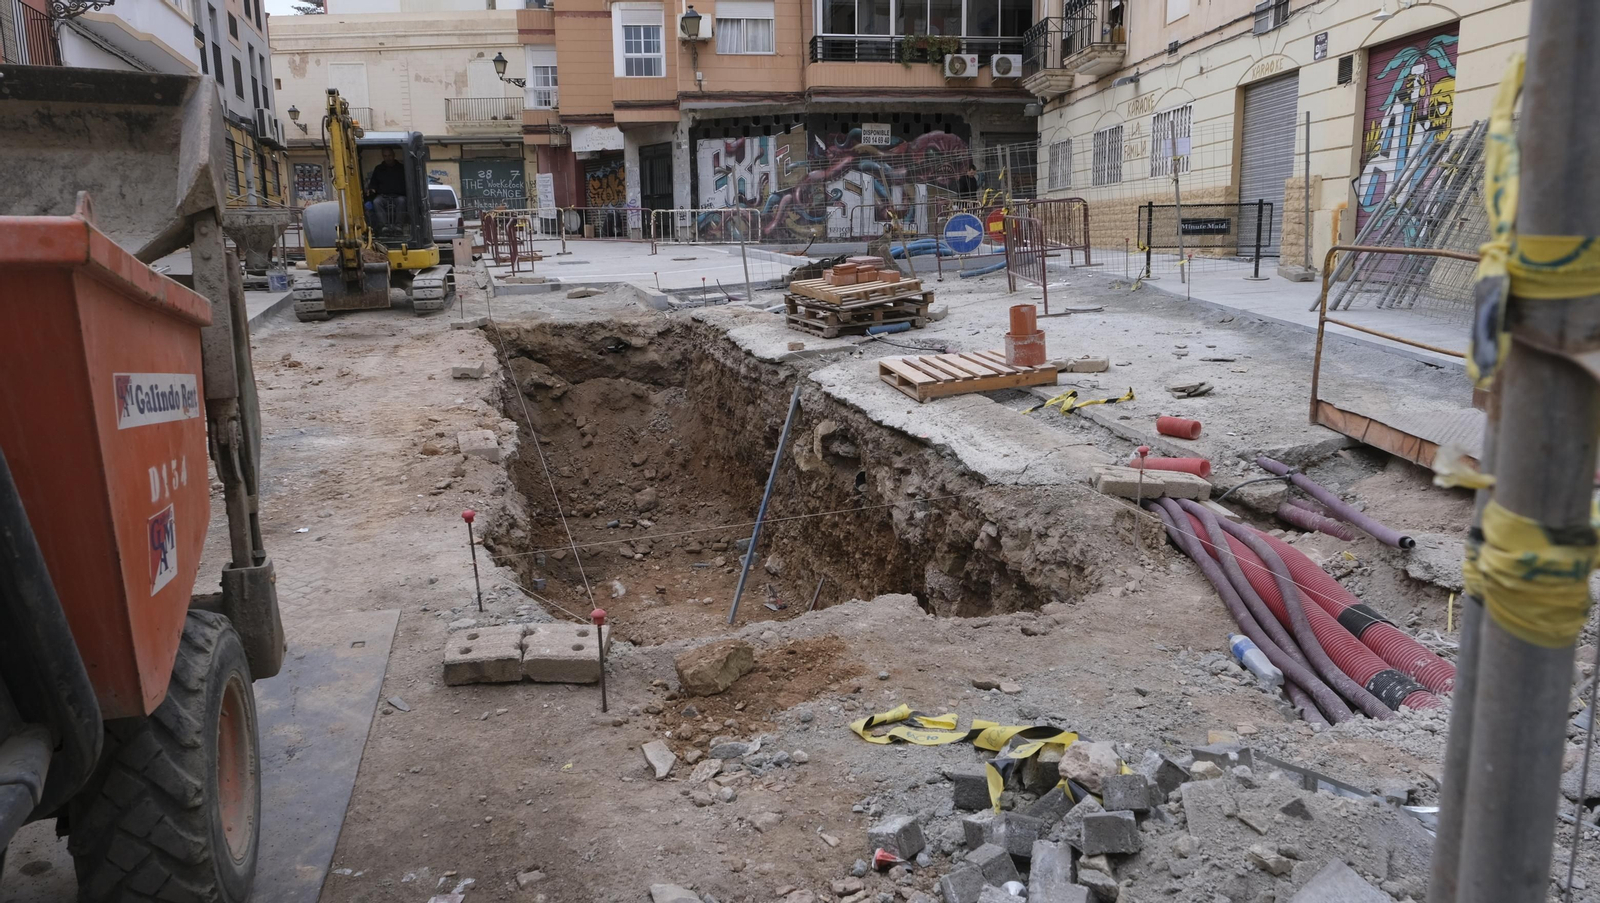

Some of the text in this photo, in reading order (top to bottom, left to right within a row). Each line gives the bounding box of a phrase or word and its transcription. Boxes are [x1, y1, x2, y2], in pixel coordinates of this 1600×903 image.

[1251, 58, 1284, 79] KARAOKE
[1127, 94, 1155, 117] KARAOKE
[1131, 122, 1141, 137] LA
[1124, 140, 1147, 158] FAMILIA
[478, 169, 521, 181] 28 7
[462, 178, 484, 190] THE
[483, 189, 522, 198] ORANGE
[135, 384, 181, 415] Galindo
[180, 383, 198, 409] Rent
